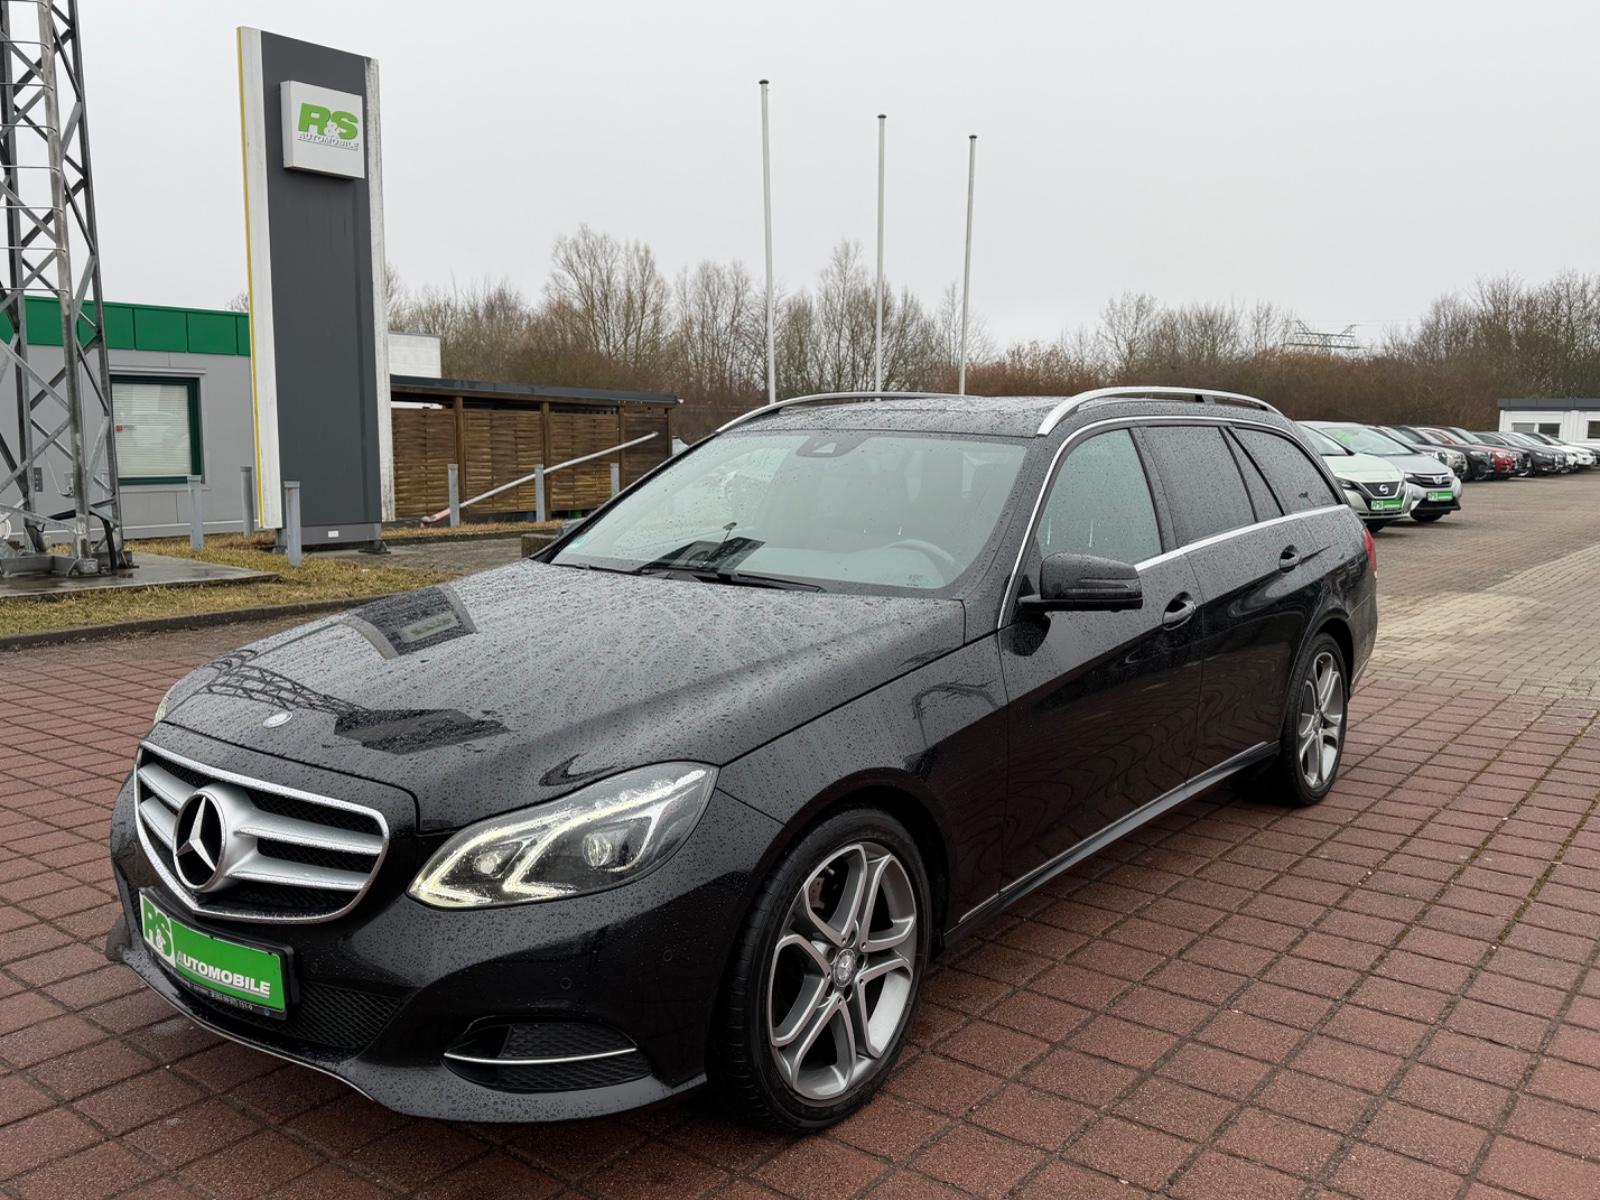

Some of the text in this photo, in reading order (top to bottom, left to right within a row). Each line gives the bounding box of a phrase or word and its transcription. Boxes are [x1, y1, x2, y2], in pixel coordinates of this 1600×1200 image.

[298, 102, 359, 141] R&S
[143, 898, 173, 958] R&S
[176, 951, 271, 996] AUTOMOBILE
